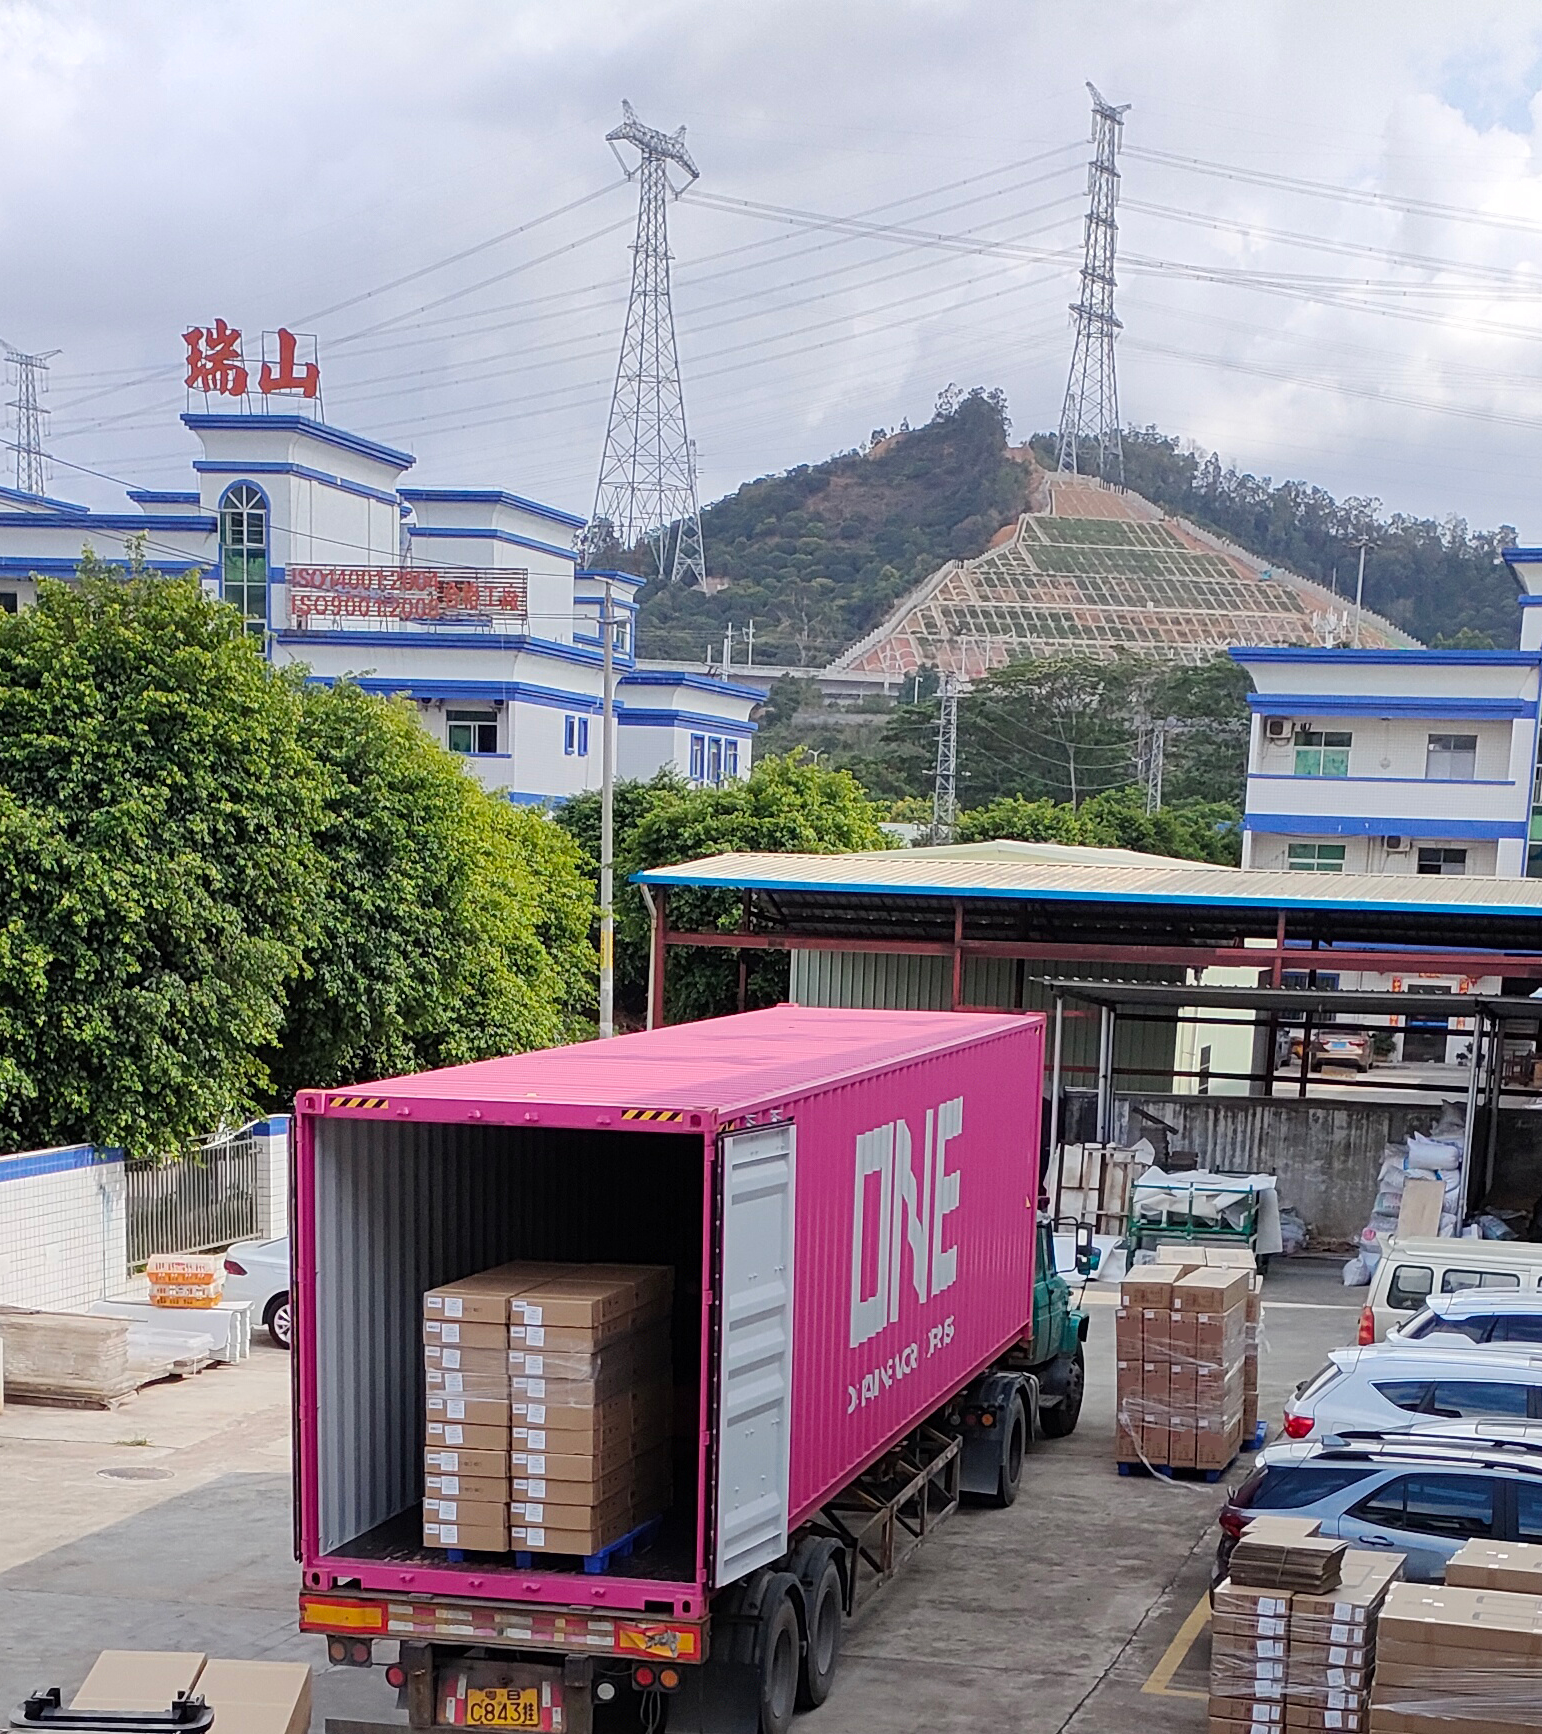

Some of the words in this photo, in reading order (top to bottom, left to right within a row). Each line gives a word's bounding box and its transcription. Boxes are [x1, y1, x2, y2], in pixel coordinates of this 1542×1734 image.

[181, 317, 320, 399] 瑞山
[849, 1096, 963, 1348] ONE
[470, 1702, 535, 1724] C843挂
